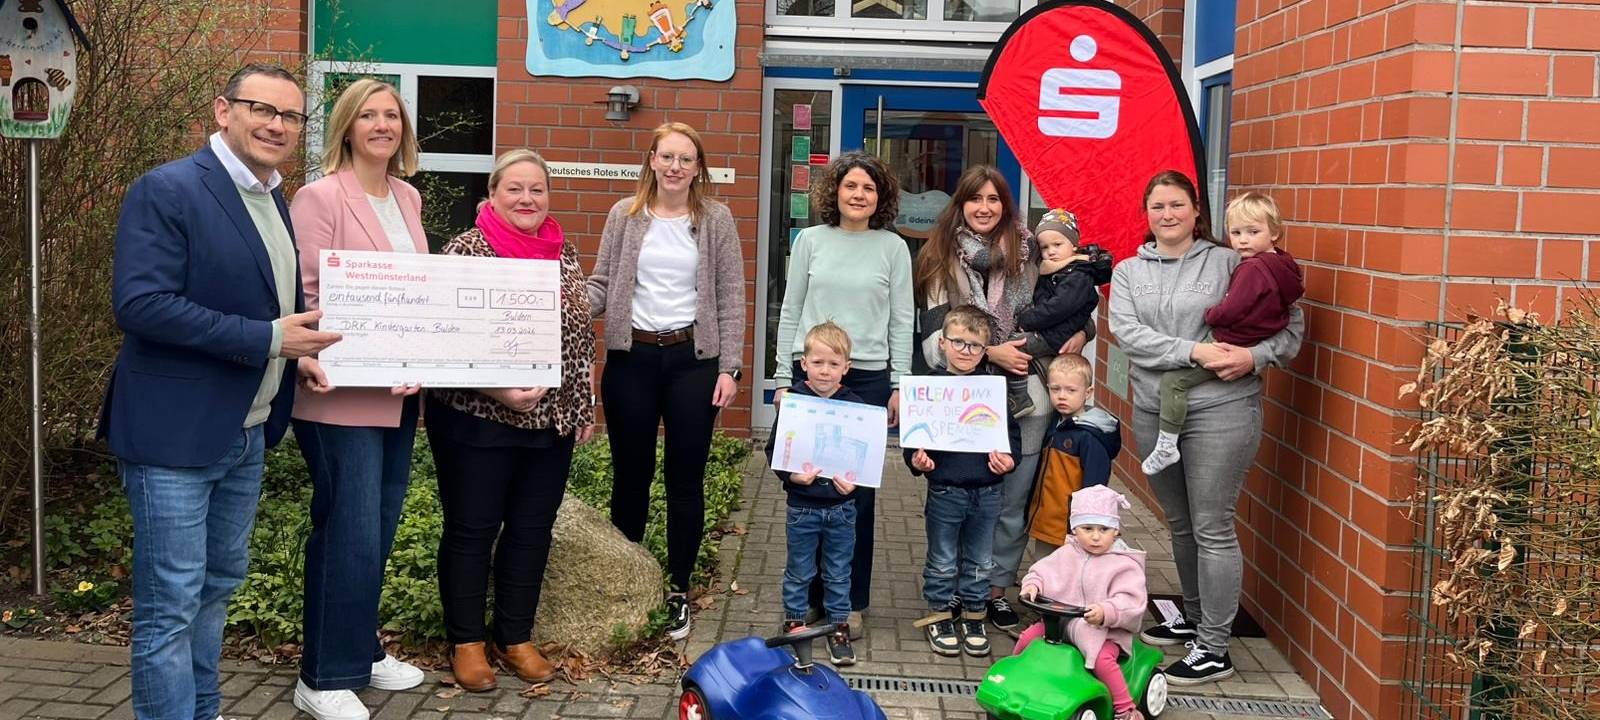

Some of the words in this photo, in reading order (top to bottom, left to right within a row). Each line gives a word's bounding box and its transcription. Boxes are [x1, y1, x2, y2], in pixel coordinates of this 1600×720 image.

[547, 166, 591, 176] Deutsches
[593, 168, 619, 177] Rotes
[345, 260, 393, 269] Sparkasse
[345, 271, 427, 282] Westmünsterland
[341, 320, 368, 330] DRK
[374, 323, 426, 338] Kindergarten
[903, 386, 954, 402] VIELEN
[943, 406, 961, 417] DIE
